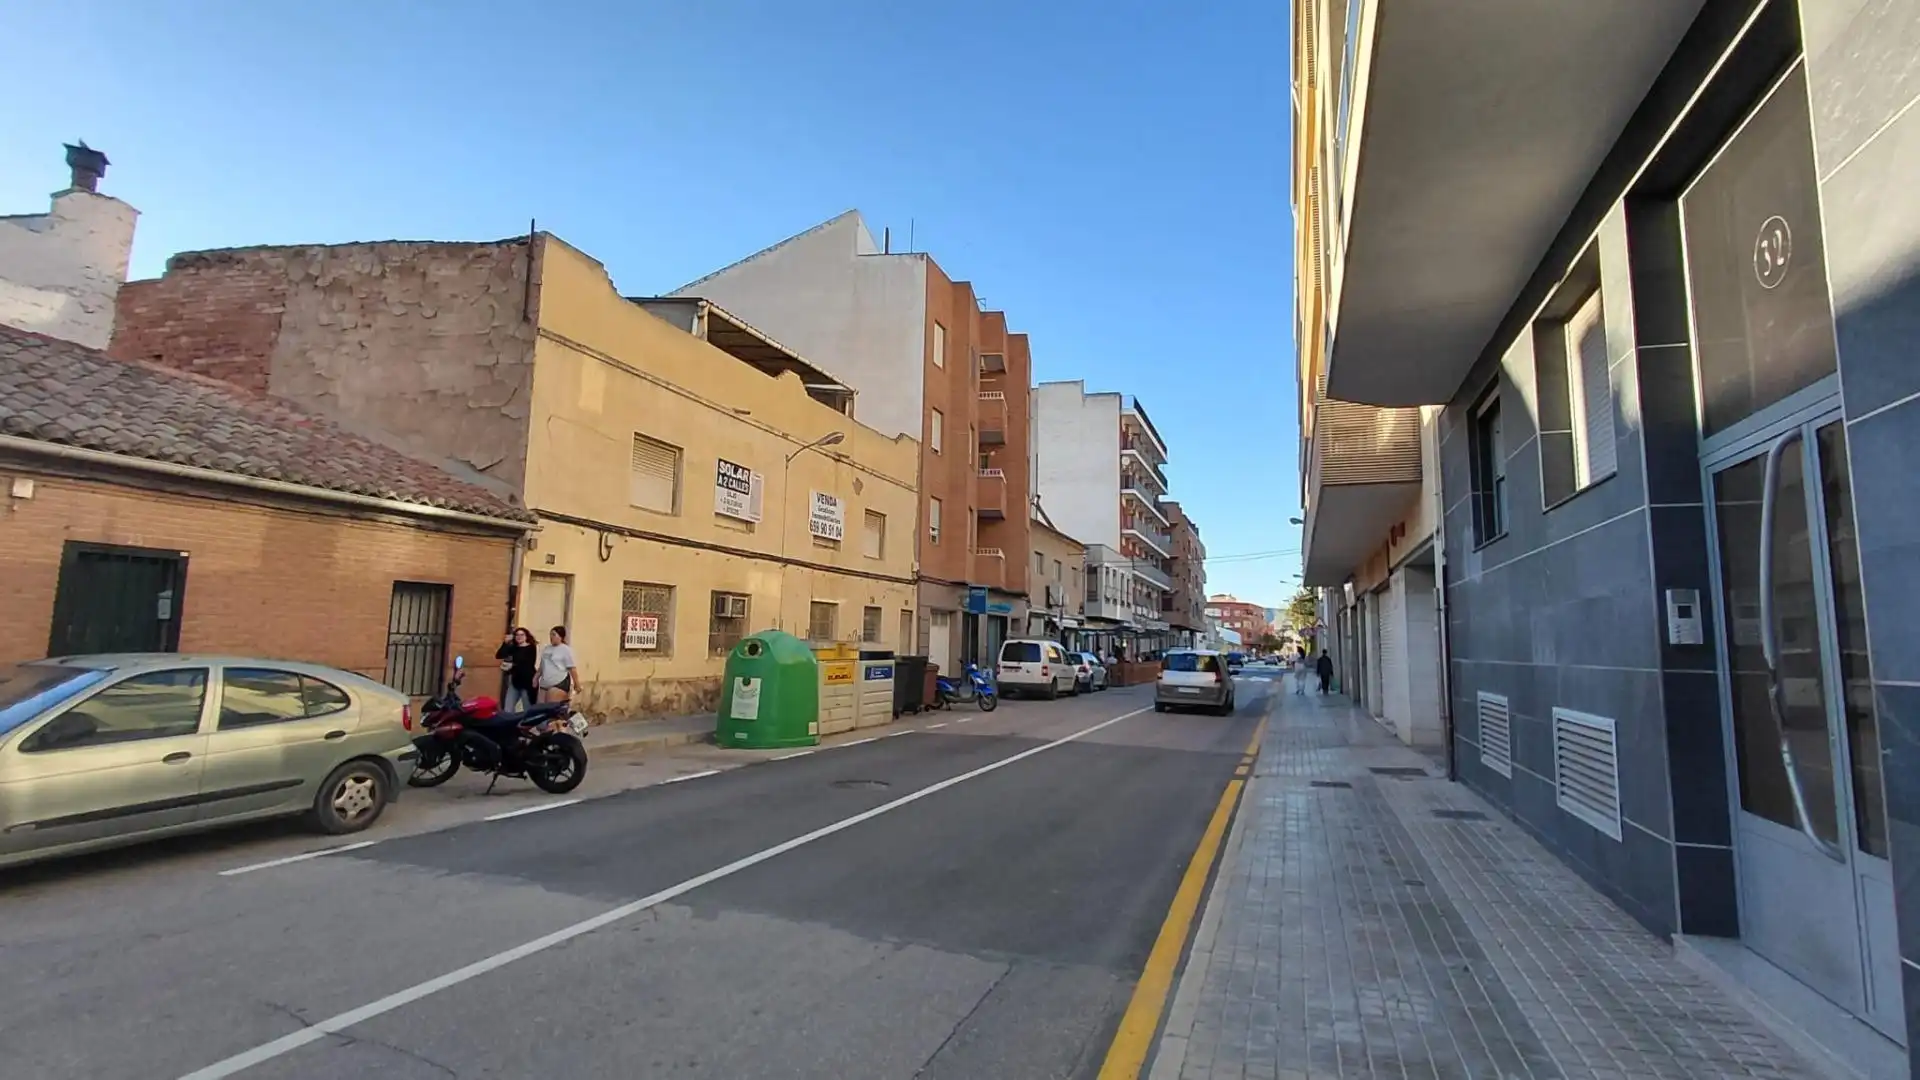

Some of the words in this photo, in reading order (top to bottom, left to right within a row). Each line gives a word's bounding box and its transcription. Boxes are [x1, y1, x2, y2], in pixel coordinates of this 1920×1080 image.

[1761, 229, 1784, 276] 32
[719, 461, 749, 482] SOLAR
[718, 474, 723, 485] A
[723, 477, 728, 487] 2
[728, 479, 750, 493] CALLES
[816, 492, 837, 507] VENDA
[631, 618, 638, 631] SE
[639, 618, 656, 632] VENDE
